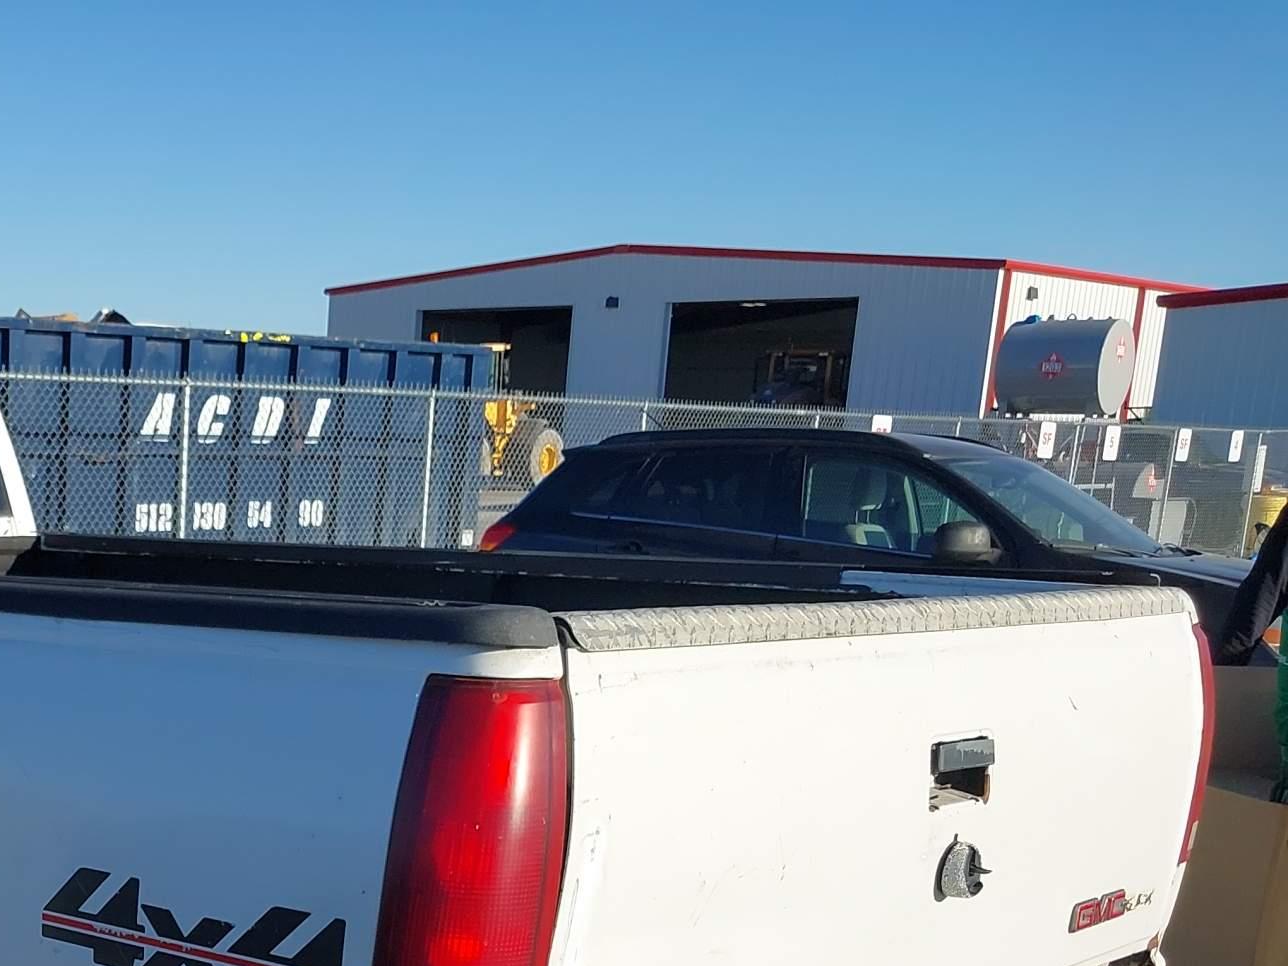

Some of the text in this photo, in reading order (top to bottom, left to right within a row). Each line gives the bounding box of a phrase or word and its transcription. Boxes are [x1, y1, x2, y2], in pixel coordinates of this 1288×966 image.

[1042, 432, 1053, 446] SF
[134, 502, 174, 533] 512
[247, 500, 272, 529] 54
[298, 499, 324, 528] 90
[1067, 888, 1127, 934] GMC
